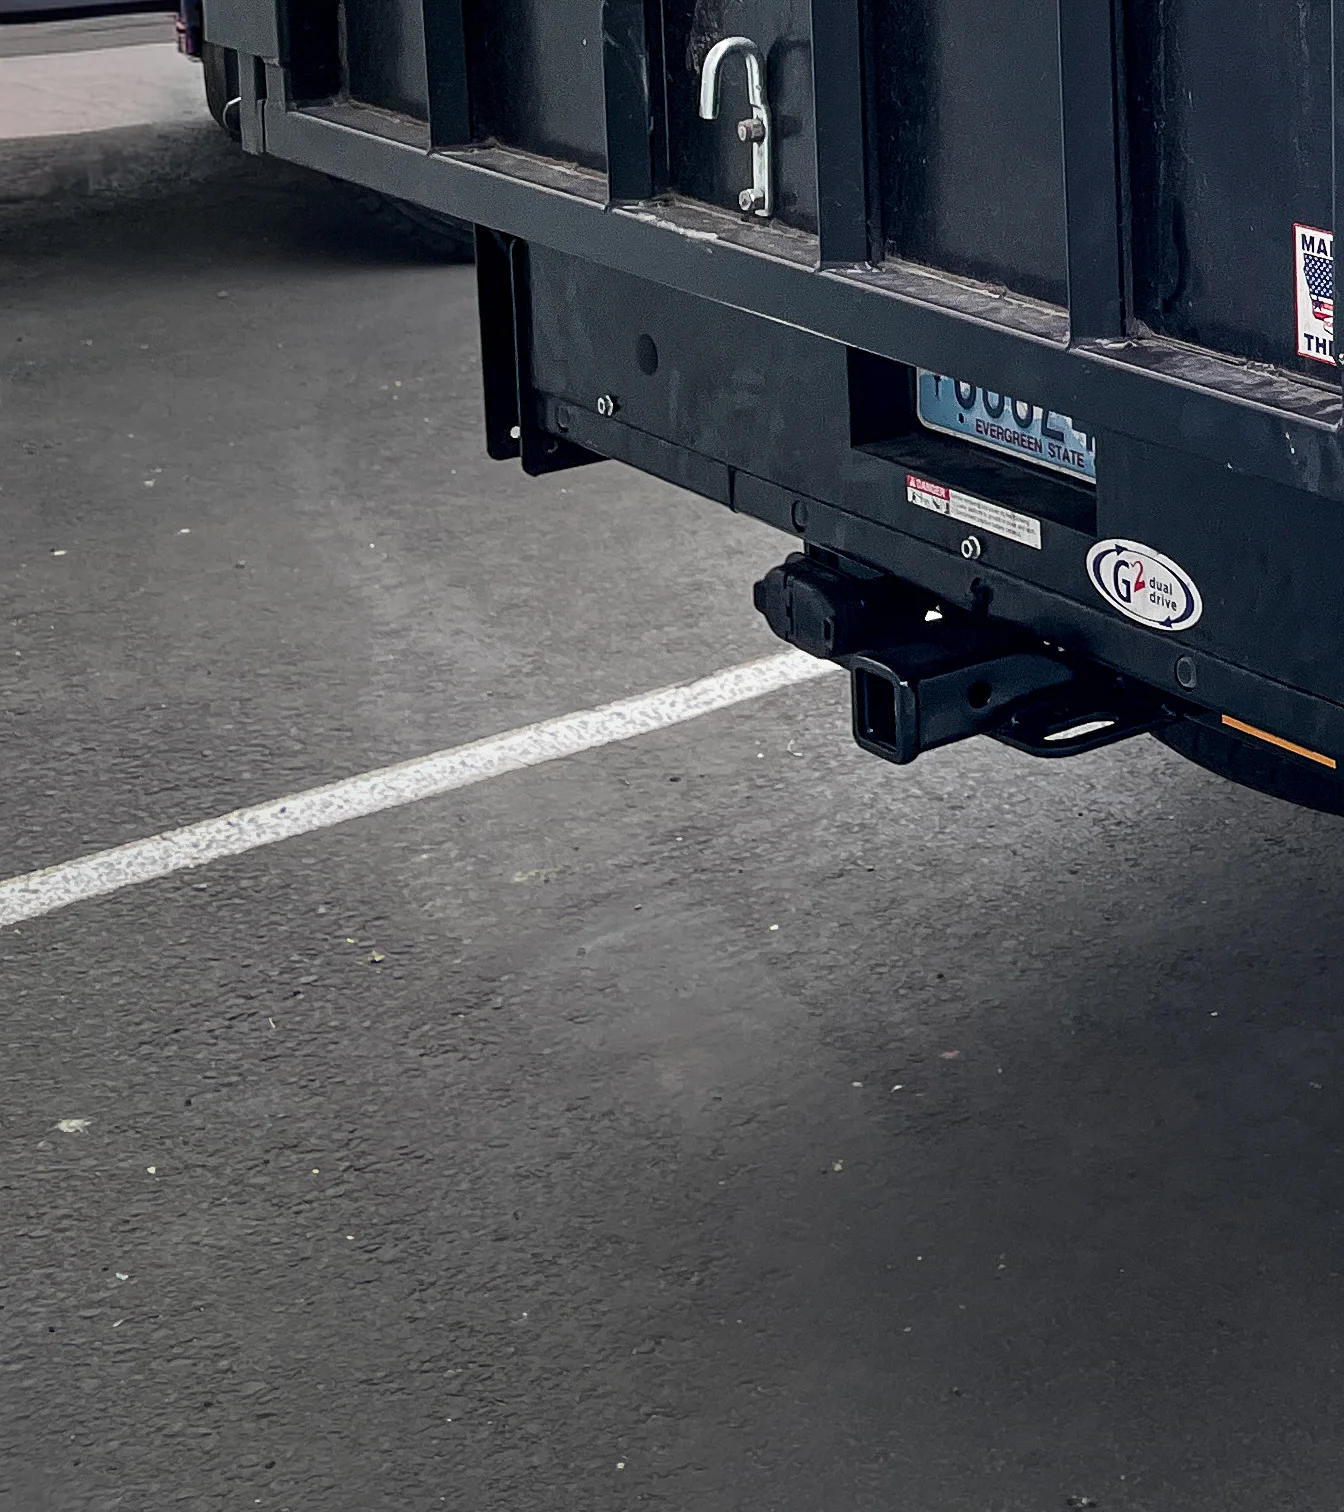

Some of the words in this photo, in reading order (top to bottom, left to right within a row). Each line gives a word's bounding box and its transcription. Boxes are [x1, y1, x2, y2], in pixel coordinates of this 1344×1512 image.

[975, 418, 1042, 454] EVERGREEN
[1048, 443, 1085, 468] STATE
[1149, 576, 1173, 595] dual
[1149, 591, 1177, 612] drive
